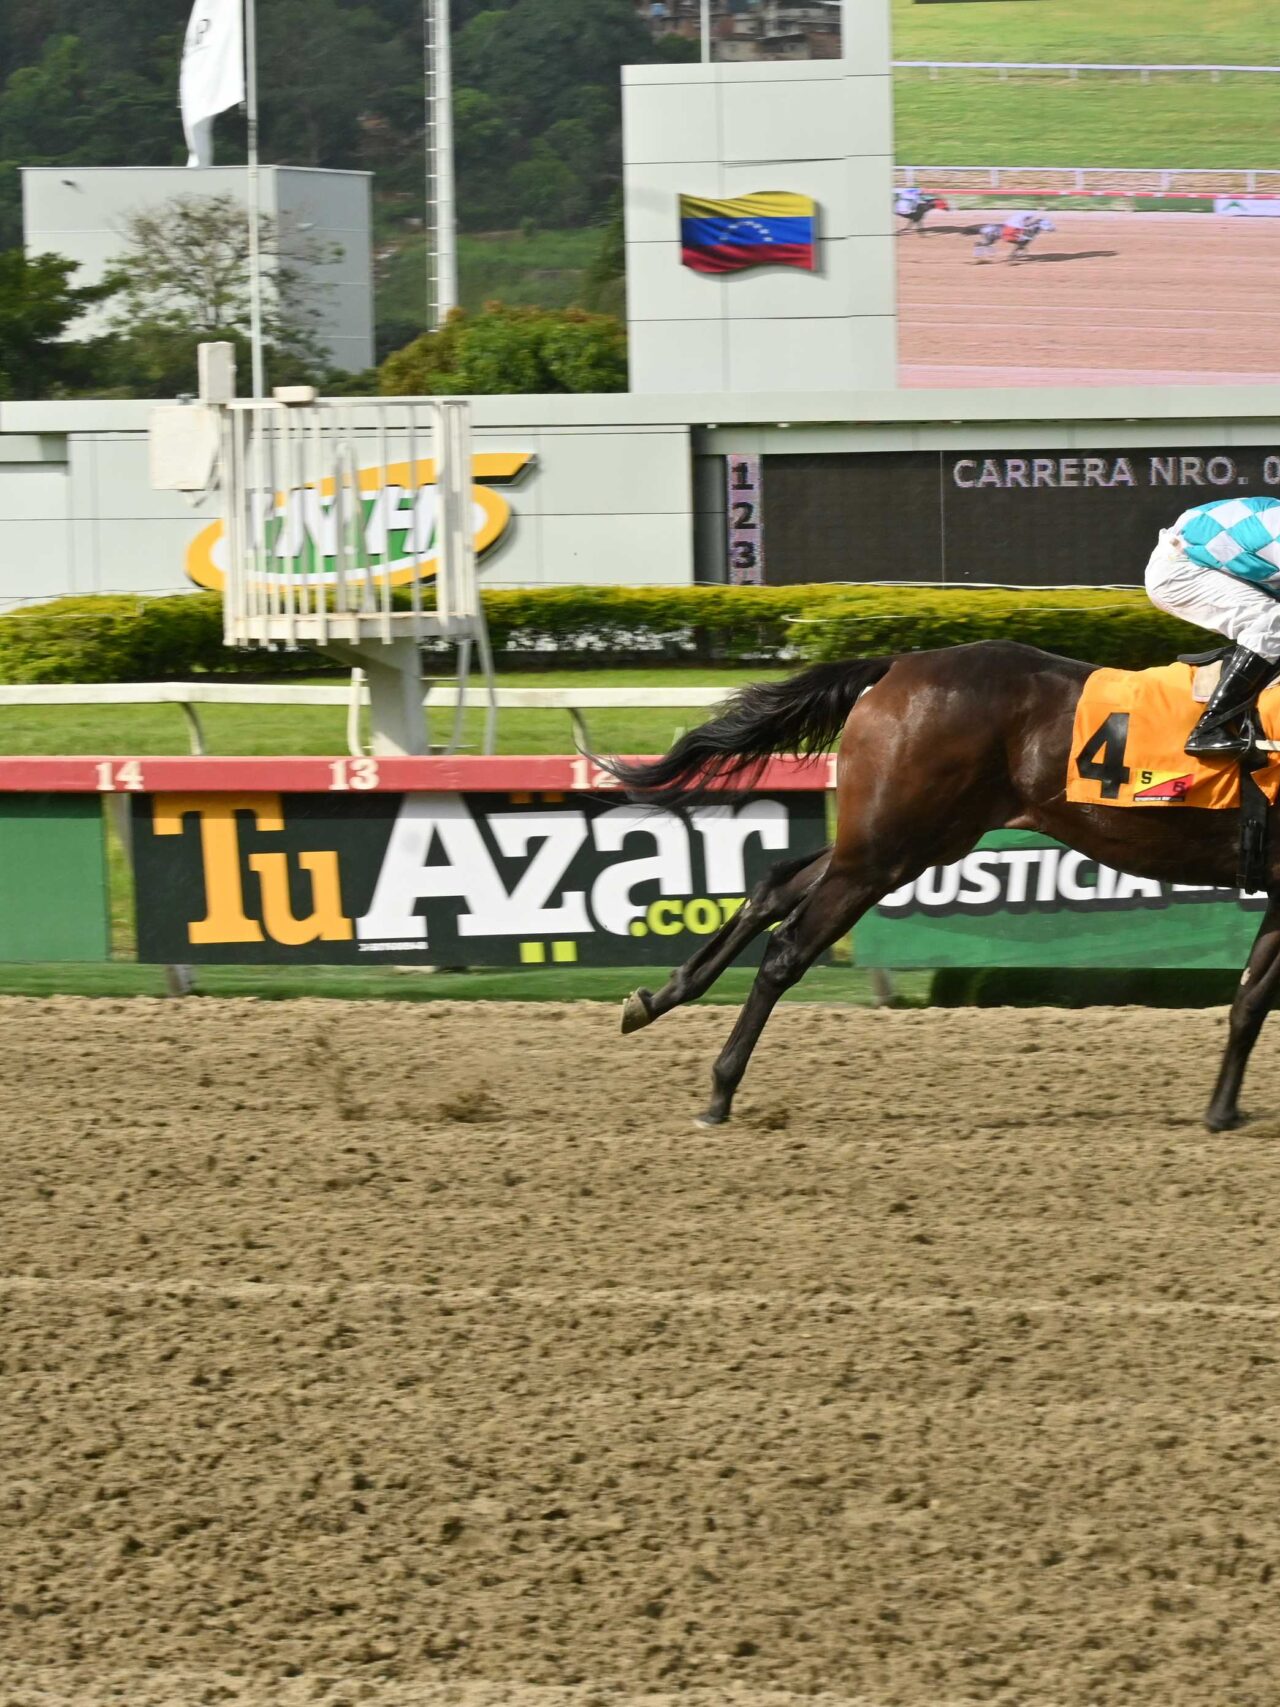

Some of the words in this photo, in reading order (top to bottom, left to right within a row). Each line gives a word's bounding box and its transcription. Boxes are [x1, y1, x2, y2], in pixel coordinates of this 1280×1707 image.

[732, 462, 754, 490] 1
[953, 457, 1138, 488] CARRERA
[1150, 456, 1249, 486] NRO.
[732, 502, 756, 530] 2
[732, 541, 756, 569] 3
[1076, 712, 1130, 799] 4
[96, 761, 144, 791] 14
[329, 760, 379, 790] 13
